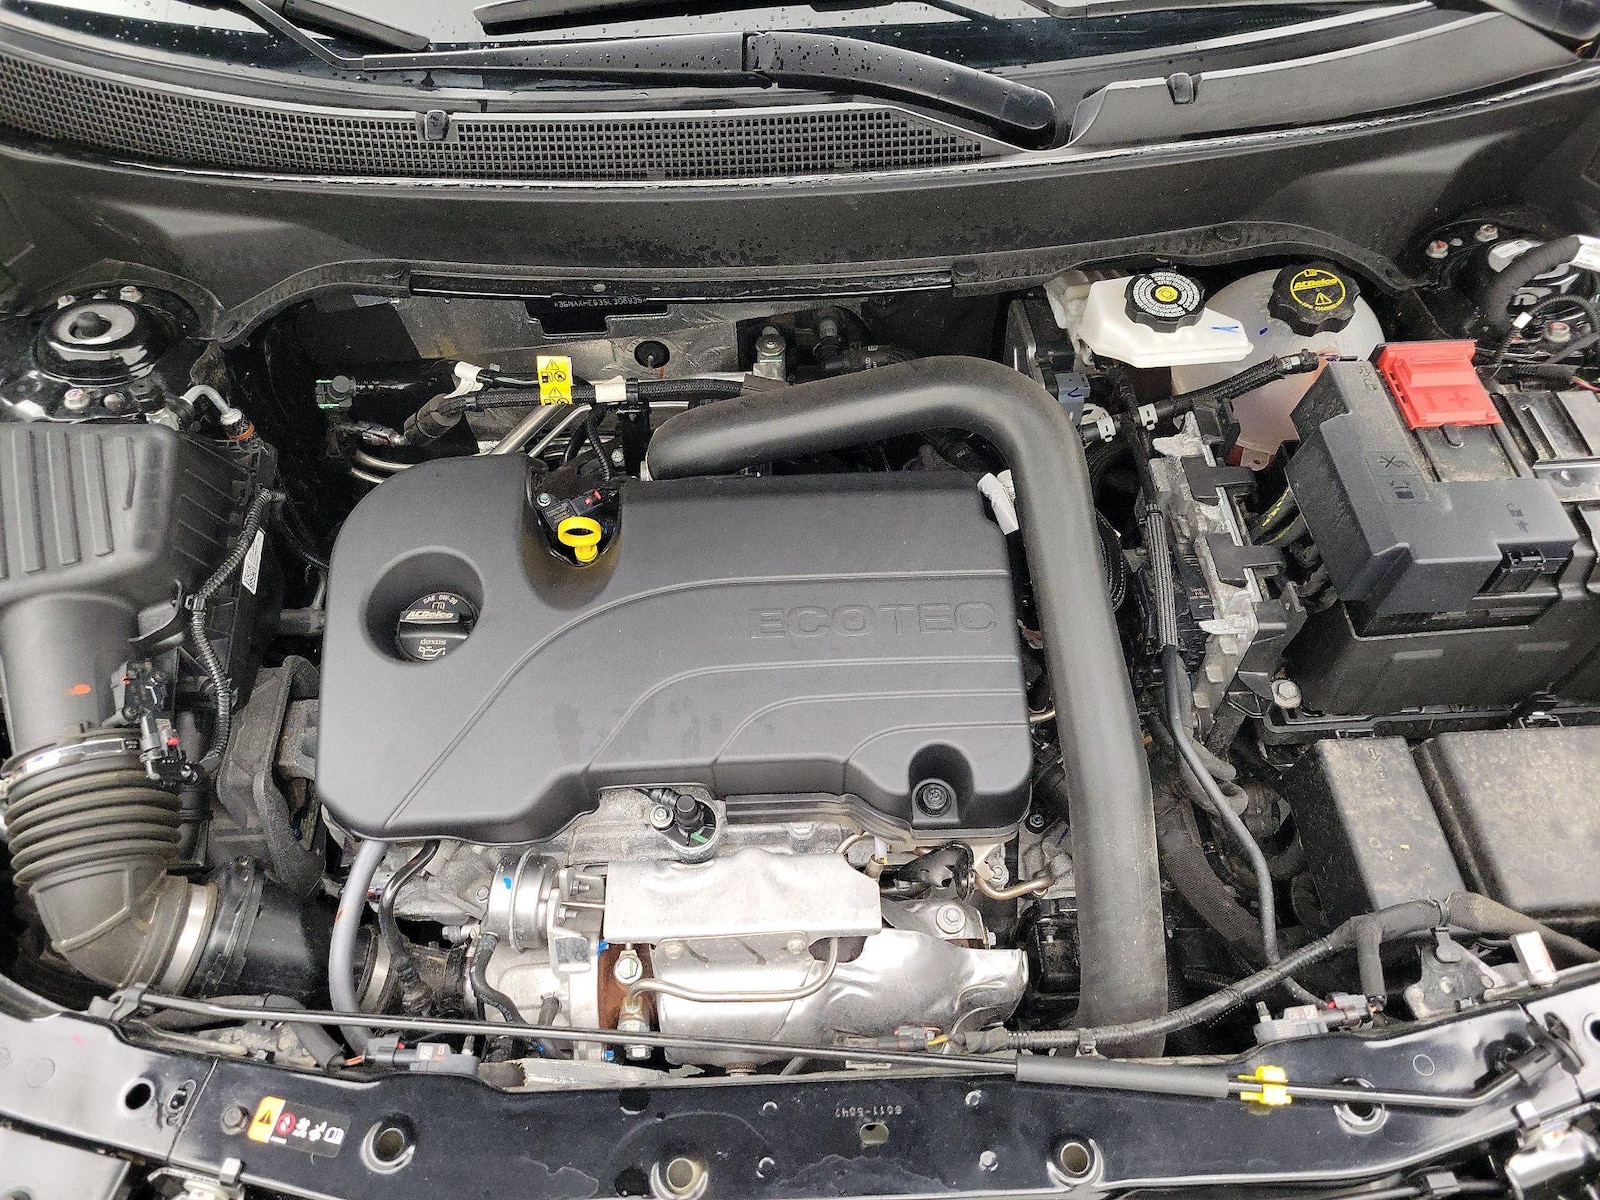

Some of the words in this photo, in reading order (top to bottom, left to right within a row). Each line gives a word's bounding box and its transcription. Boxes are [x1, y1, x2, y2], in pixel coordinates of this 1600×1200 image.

[422, 594, 436, 605] SAE
[406, 610, 454, 620] ACDelco
[749, 601, 997, 638] ECOTEC
